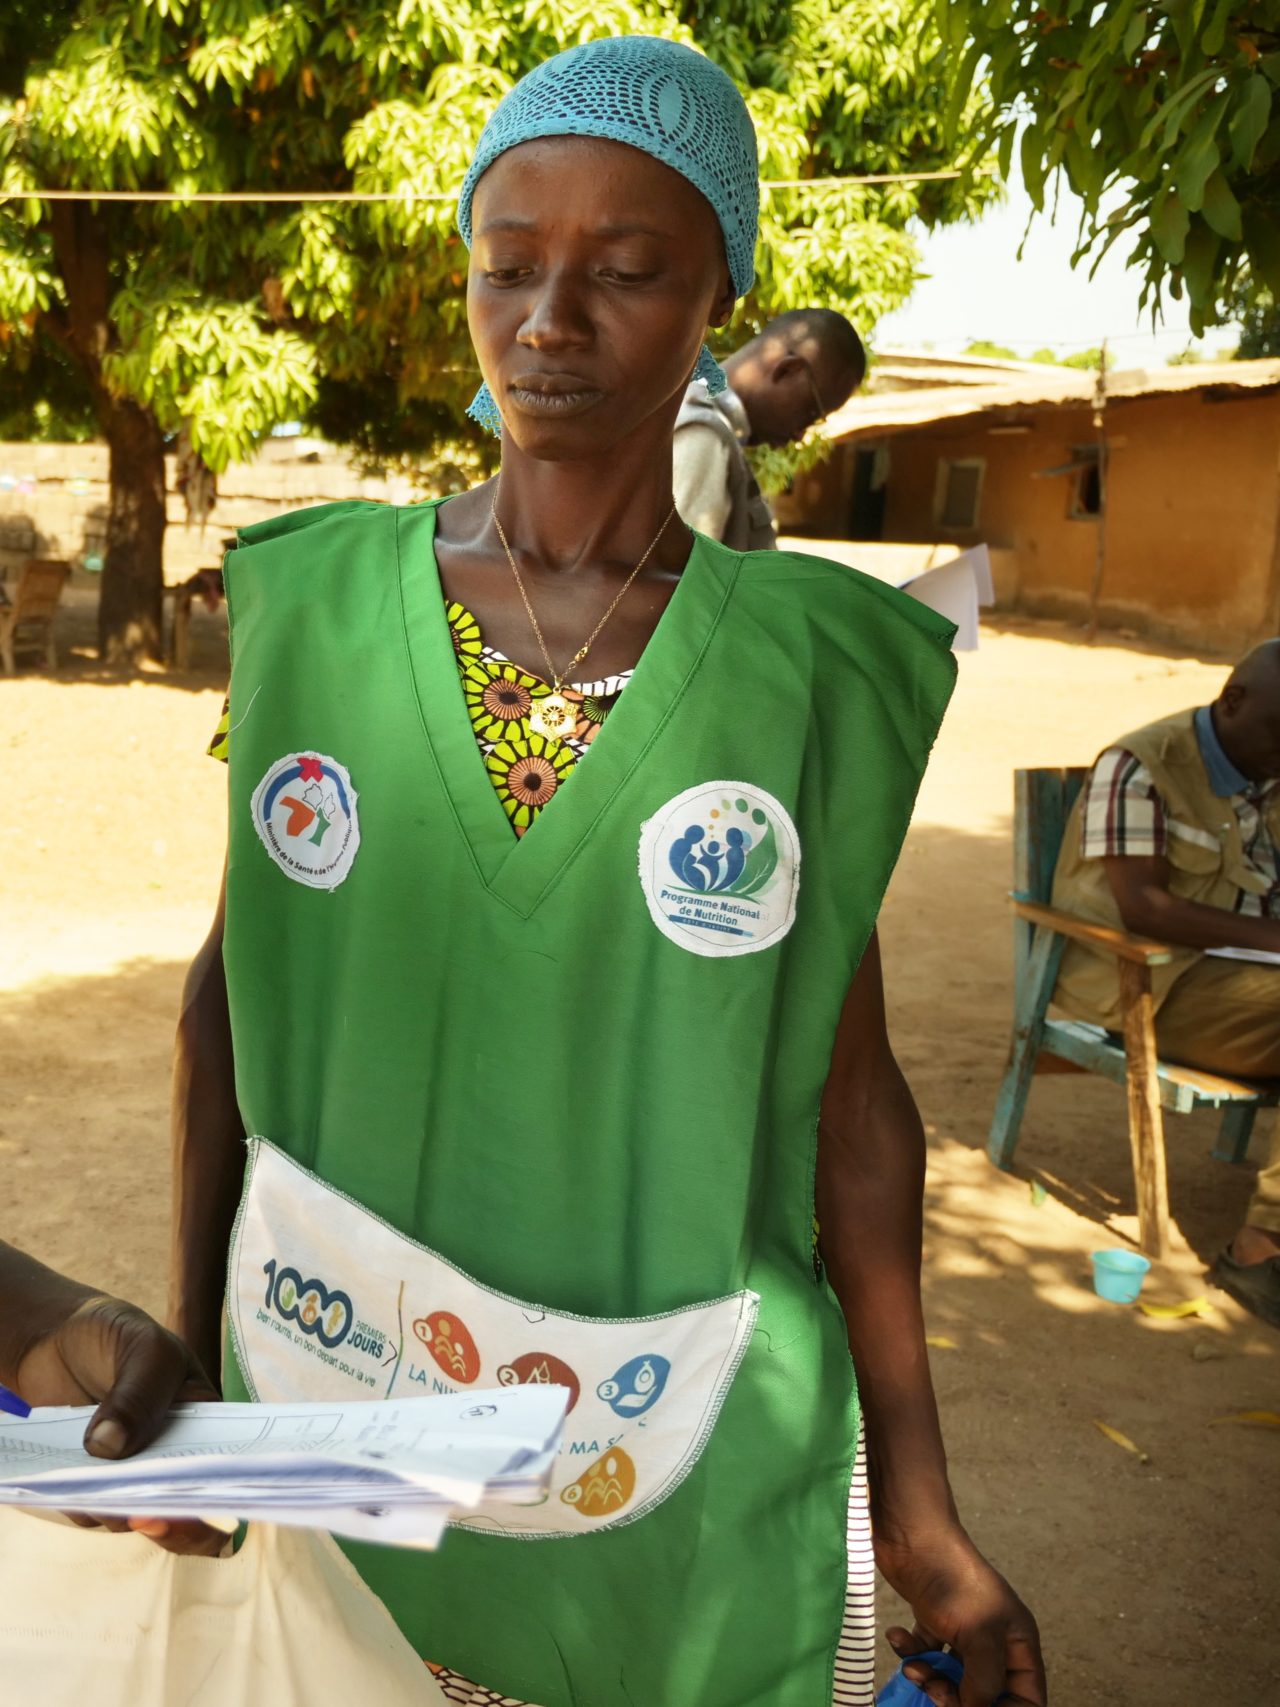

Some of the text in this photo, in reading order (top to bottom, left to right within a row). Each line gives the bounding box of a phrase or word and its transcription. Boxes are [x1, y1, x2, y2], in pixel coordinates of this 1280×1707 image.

[280, 851, 288, 860] de
[287, 857, 294, 865] la
[294, 862, 313, 874] Santé
[660, 889, 760, 919] Programme National
[679, 905, 692, 916] de
[694, 908, 738, 926] Nutrition
[263, 1258, 353, 1348] 1000
[356, 1320, 387, 1343] PREMIERS
[347, 1331, 384, 1358] JOURS
[408, 1363, 427, 1386] LA
[505, 1371, 514, 1384] 2
[605, 1385, 613, 1396] 3
[570, 1440, 600, 1455] MA
[567, 1487, 577, 1499] 6
